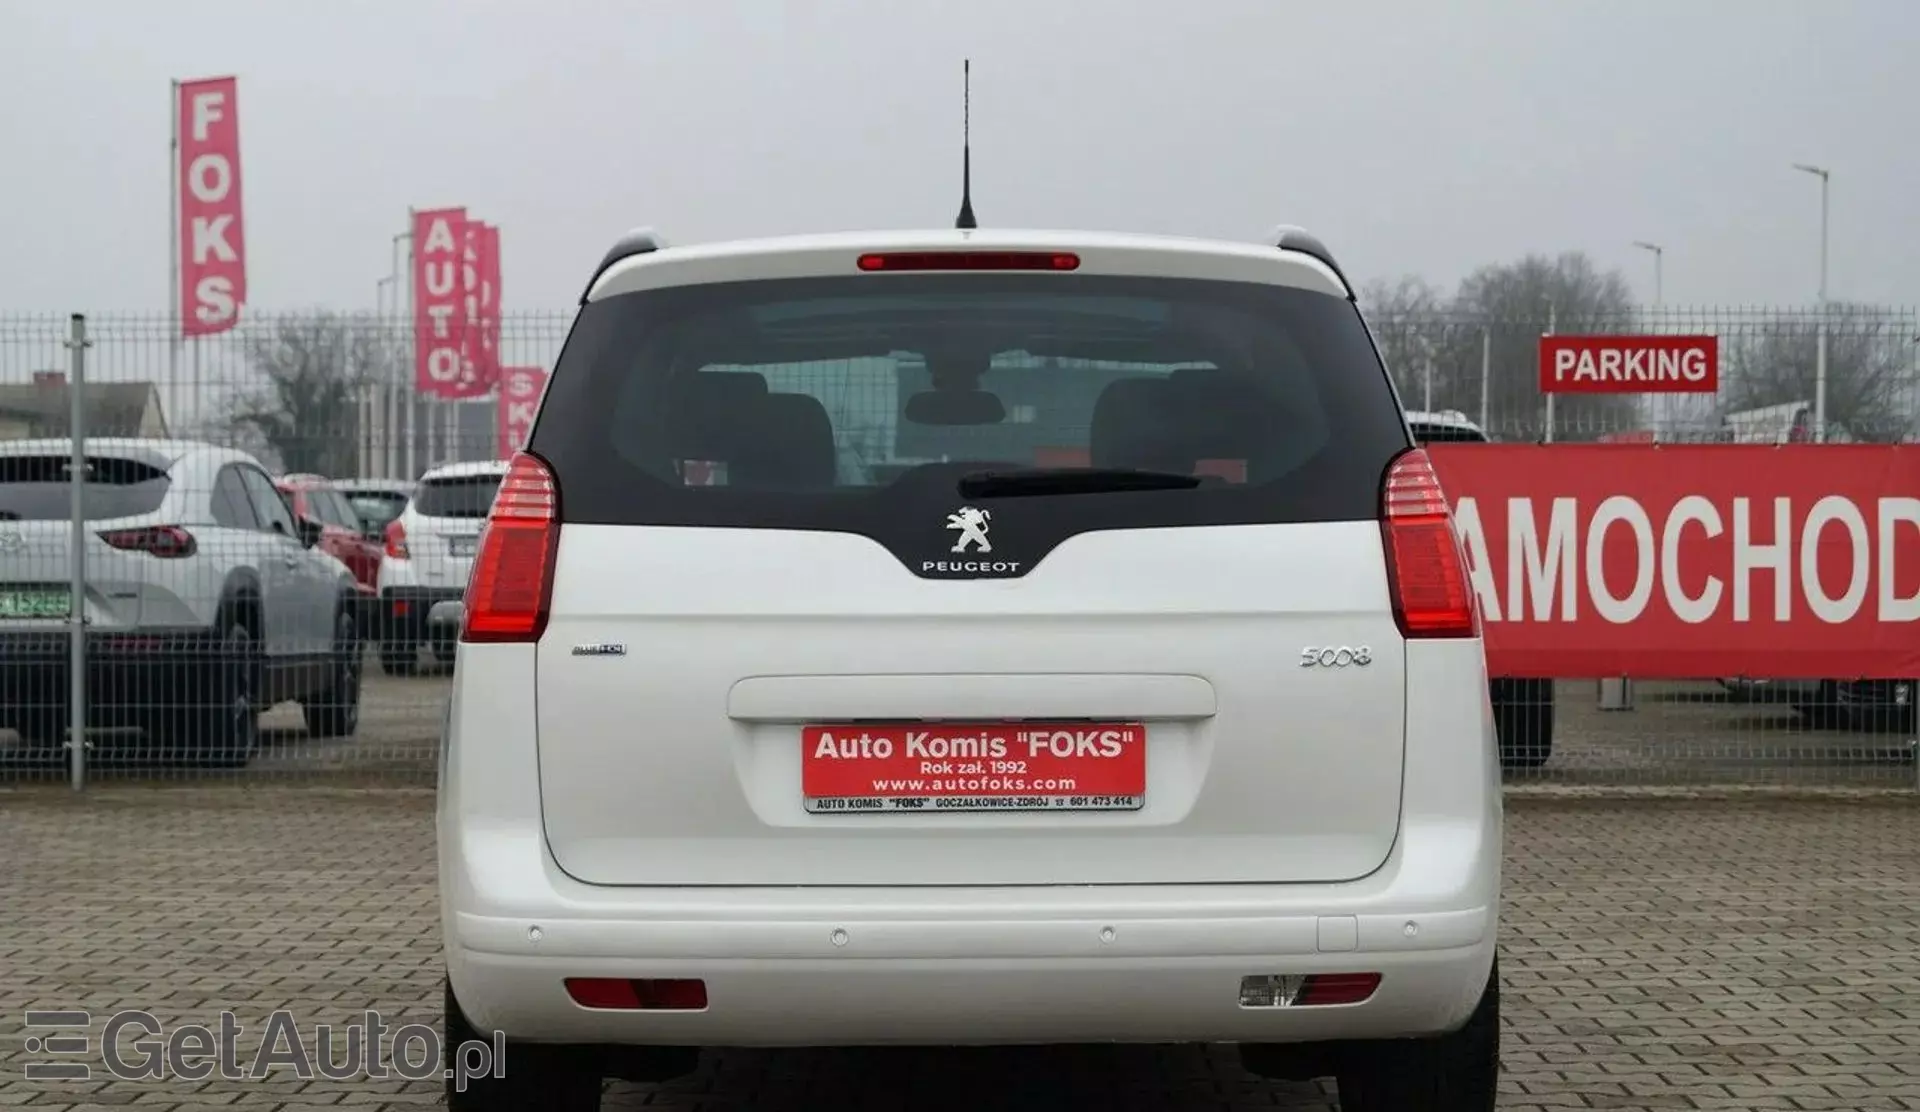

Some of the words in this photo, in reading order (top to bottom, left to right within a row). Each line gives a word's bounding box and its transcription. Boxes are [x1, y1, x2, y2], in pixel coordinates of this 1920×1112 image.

[188, 91, 238, 325] FOKS
[424, 218, 460, 381] AUTO
[1554, 348, 1706, 381] PARKING
[922, 560, 1021, 572] PEUGEOT
[1299, 645, 1372, 667] 5008
[814, 731, 893, 759] Auto
[905, 730, 1008, 758] Komis
[1016, 730, 1134, 758] "FOKS"
[920, 761, 953, 774] Rok
[958, 761, 986, 774] zał.
[990, 760, 1027, 774] 1992
[872, 775, 1076, 790] www.autofoks.com
[816, 799, 844, 809] AUTO
[847, 798, 883, 808] KOMIS
[889, 797, 930, 808] "FOKS"
[1070, 796, 1089, 805] 601
[1092, 796, 1111, 806] 473
[1113, 795, 1133, 805] 414
